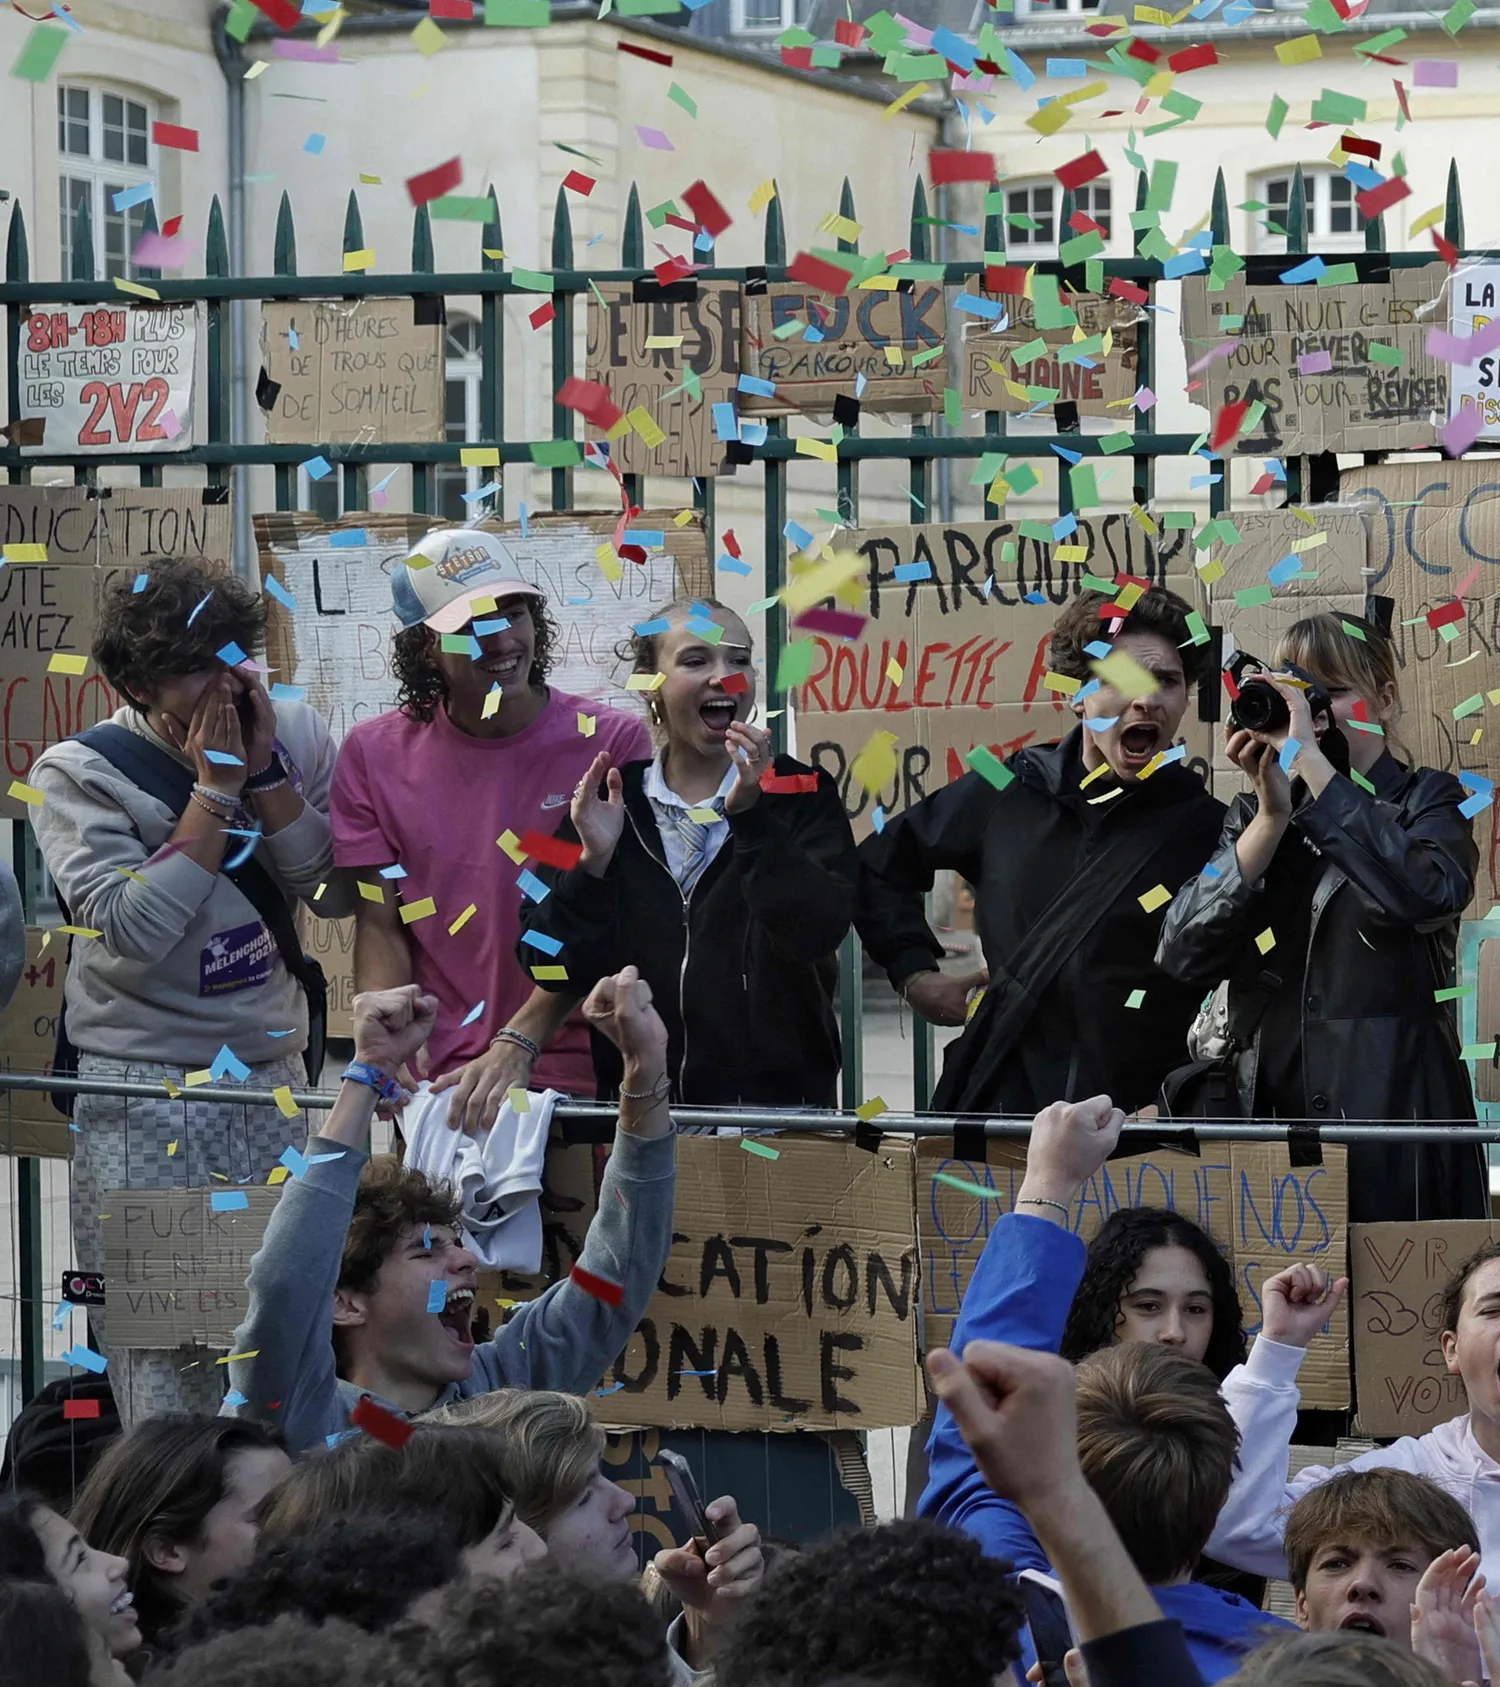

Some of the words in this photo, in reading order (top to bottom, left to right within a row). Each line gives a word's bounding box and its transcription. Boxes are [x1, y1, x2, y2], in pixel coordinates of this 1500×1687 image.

[1465, 282, 1495, 308] LA
[27, 308, 127, 353] 8H-18H
[133, 308, 186, 343] PLUS
[314, 316, 400, 346] D'HEURES
[770, 286, 945, 350] FUCK
[1225, 296, 1260, 336] LA
[1285, 298, 1348, 332] NUiT
[24, 352, 51, 380] LE
[56, 347, 122, 378] TEMPS
[131, 345, 179, 376] POUR
[290, 354, 313, 377] DE
[331, 350, 387, 374] TROUS
[397, 352, 440, 382] QUE
[760, 346, 930, 380] PARCOURSUP
[1226, 337, 1280, 370] POUR
[282, 394, 314, 421] DE
[328, 381, 427, 415] SOMMEiL
[1223, 377, 1283, 415] PAS
[1293, 378, 1351, 407] POUR
[1366, 365, 1448, 411] RÉVISER
[27, 381, 65, 409] LES
[77, 376, 171, 447] 2V2
[0, 504, 208, 556] DUCATION
[437, 546, 489, 577] STETSON
[800, 634, 1014, 714] ROULETTE
[124, 1205, 228, 1239] FUCK
[931, 1158, 1013, 1245] ON
[1240, 1168, 1333, 1253] NOS
[126, 1250, 156, 1283] LE
[126, 1289, 186, 1315] VIVE
